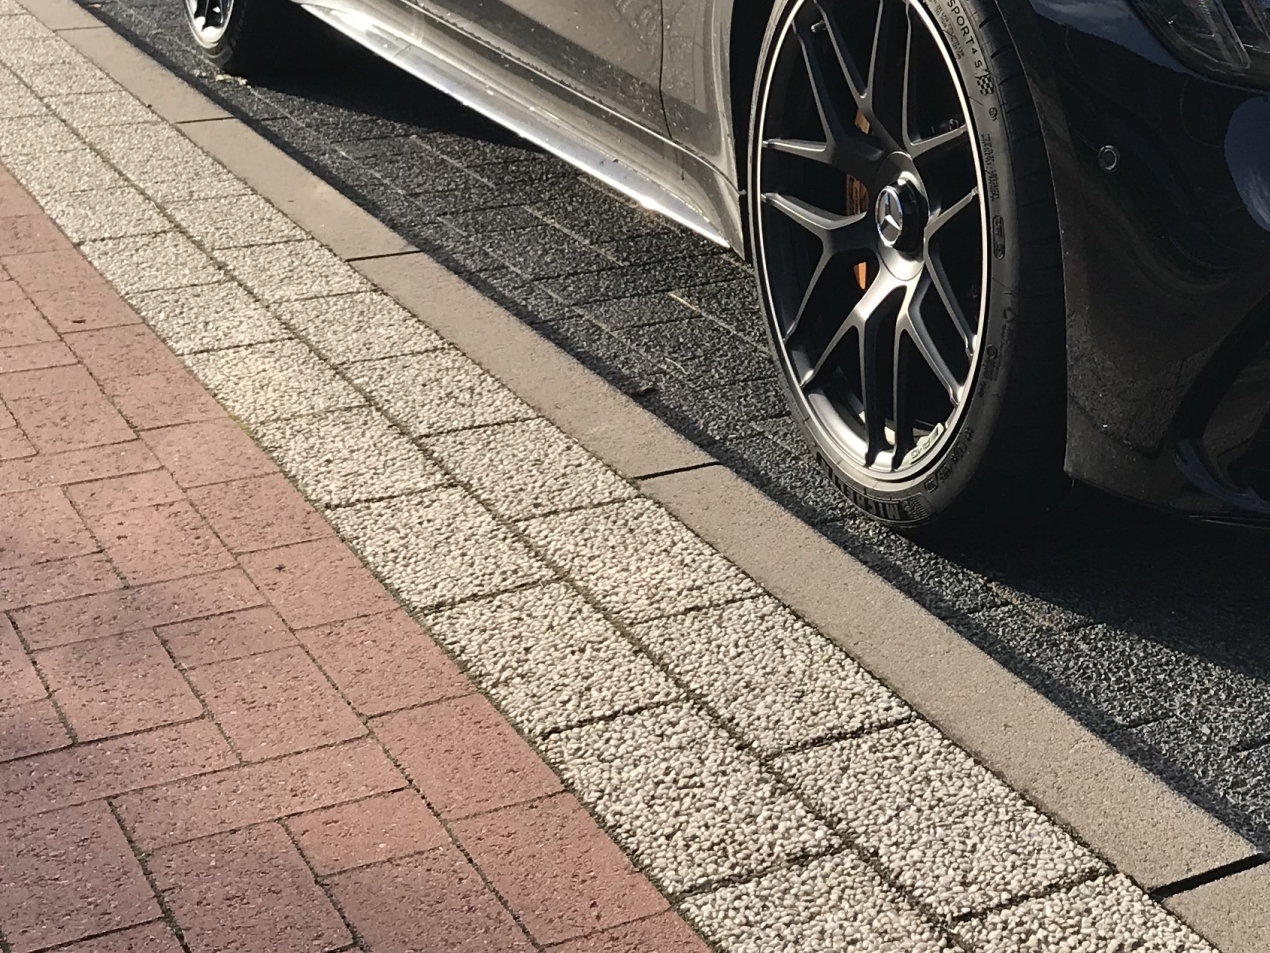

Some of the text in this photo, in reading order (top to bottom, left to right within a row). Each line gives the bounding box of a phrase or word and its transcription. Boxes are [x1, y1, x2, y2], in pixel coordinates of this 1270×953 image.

[947, 0, 975, 45] SPORT
[971, 47, 978, 55] 4
[974, 59, 982, 69] S
